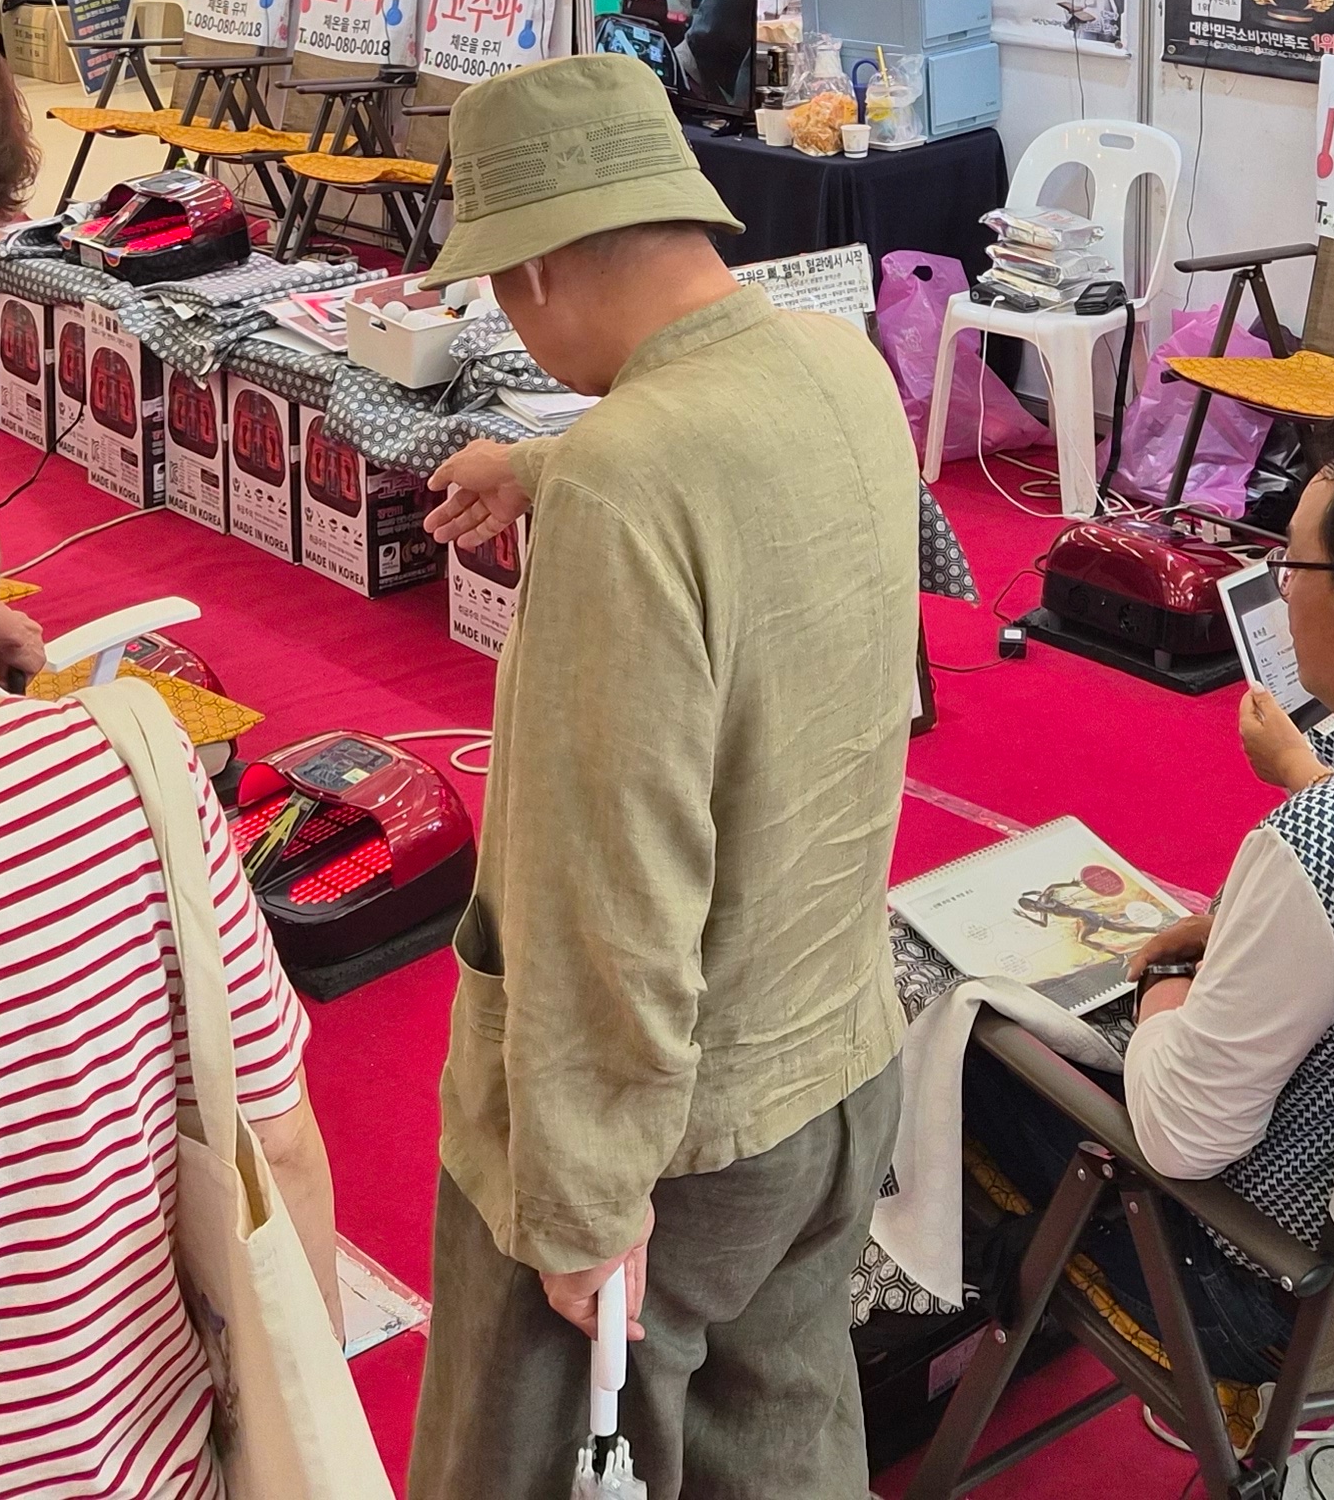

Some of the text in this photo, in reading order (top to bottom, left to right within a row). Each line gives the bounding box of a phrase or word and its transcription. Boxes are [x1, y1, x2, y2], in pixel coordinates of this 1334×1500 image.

[232, 2, 247, 17] 유지
[194, 13, 262, 37] 080-080-0018
[323, 17, 370, 34] 체온을 유지
[1189, 21, 1310, 50] 대한민국소비자만족도
[310, 33, 390, 56] 080-080-0018
[450, 33, 501, 56] 체온을 유지
[846, 250, 862, 265] 시작
[1, 416, 44, 446] MADE KOREA
[58, 440, 76, 456] MADE
[91, 472, 140, 504] MADE KOREA
[168, 495, 222, 527] MADE KOREA
[233, 518, 289, 554] MADE KOREA
[305, 548, 365, 587] MADE KOREA
[453, 620, 479, 643] MADE
